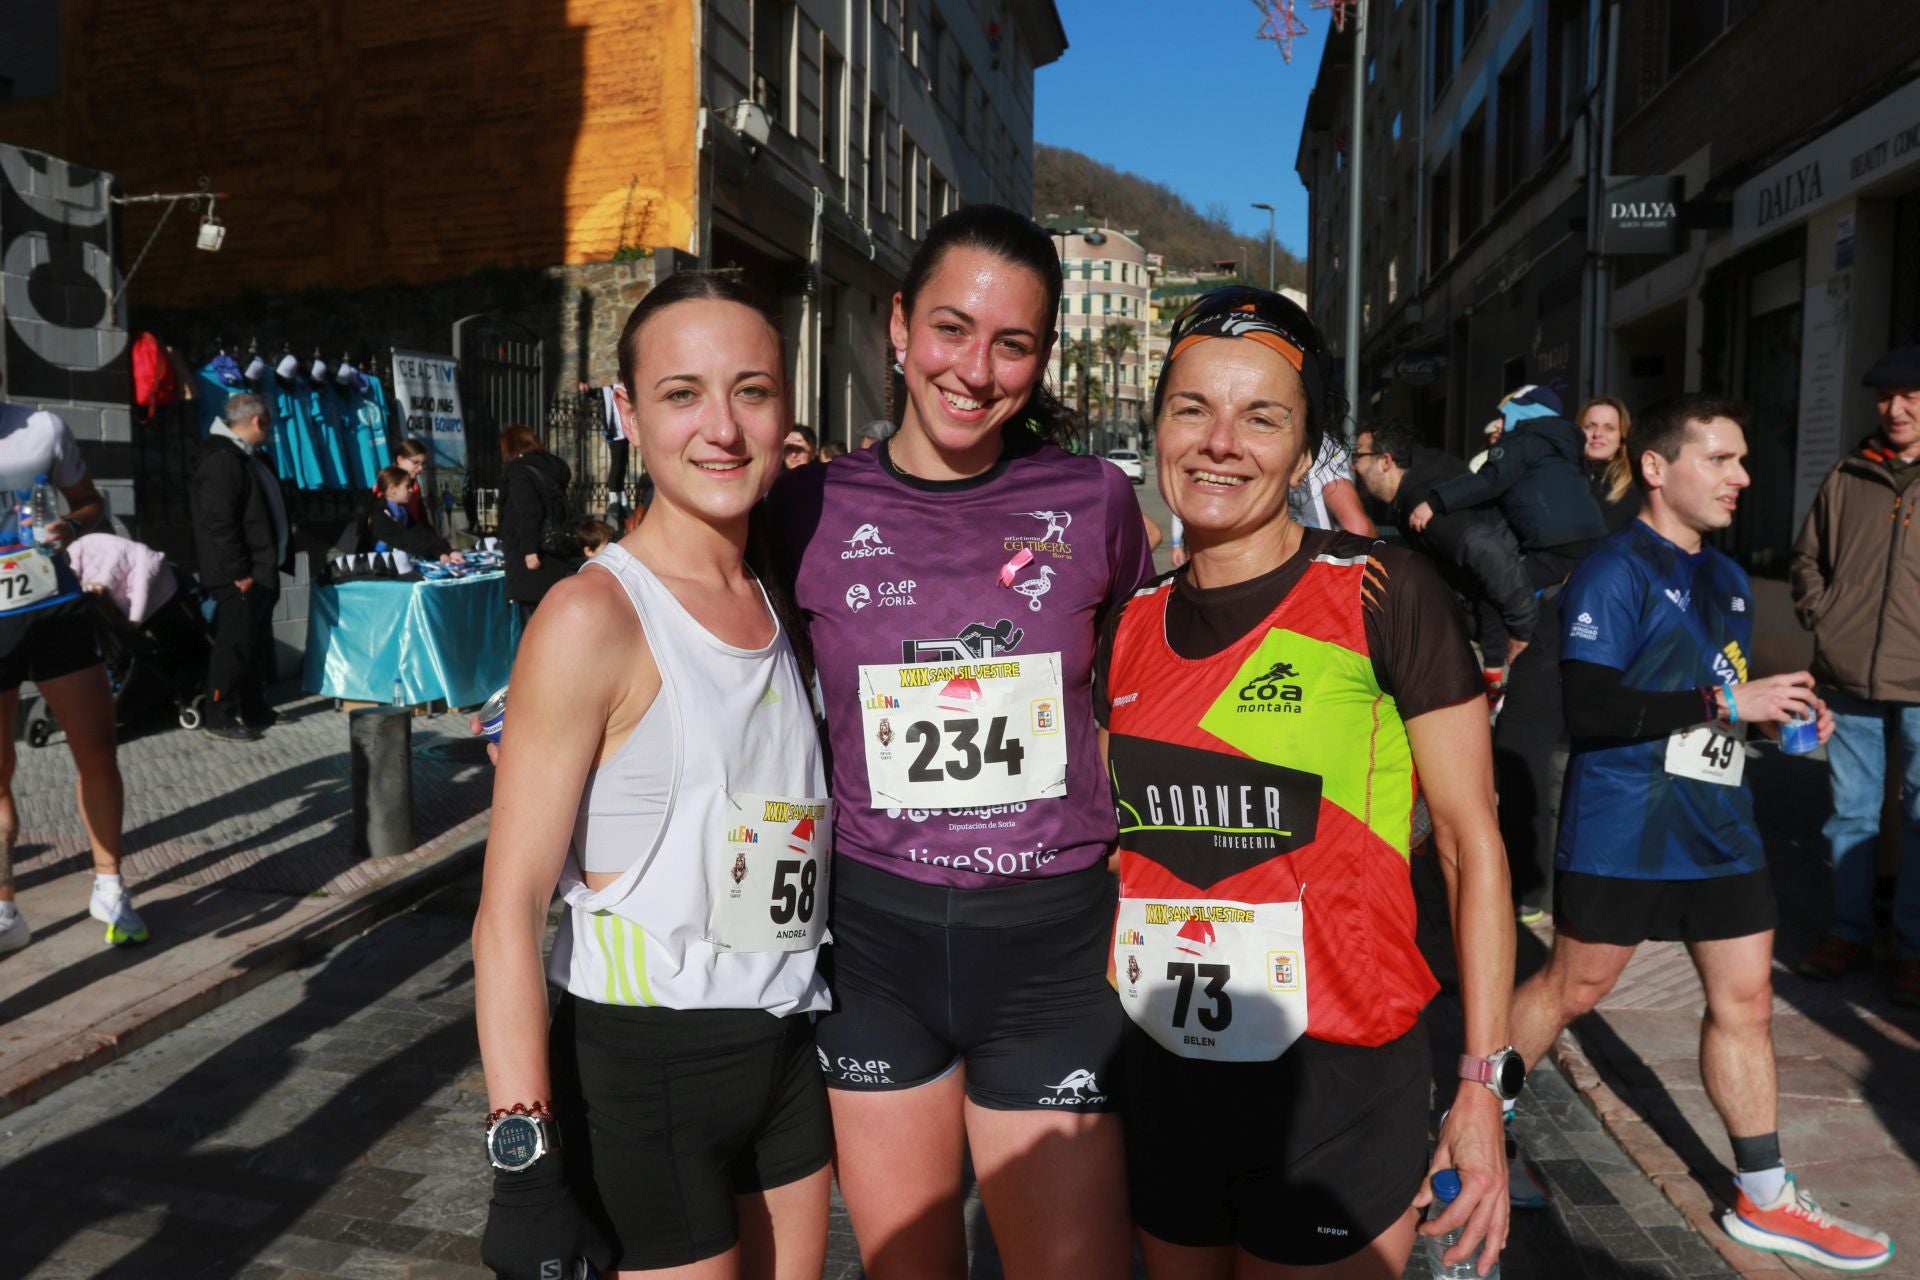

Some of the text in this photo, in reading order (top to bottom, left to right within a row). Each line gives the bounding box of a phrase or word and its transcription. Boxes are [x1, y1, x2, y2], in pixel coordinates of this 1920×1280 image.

[1758, 159, 1823, 227] DALYA
[1611, 202, 1677, 218] DALYA
[435, 416, 463, 432] EQUIPO
[841, 547, 895, 560] austral
[0, 574, 33, 600] 72
[899, 662, 1020, 687] XXIX SAN SILVESTRE
[866, 693, 900, 710] LLENA
[1239, 684, 1303, 702] coa
[1236, 702, 1302, 714] montaña
[905, 716, 1025, 783] 234
[1701, 733, 1735, 769] 49
[763, 801, 790, 823] XXIX
[1146, 784, 1280, 830] CORNER
[948, 816, 1016, 832] Diputación de Soria
[727, 824, 759, 844] LLENA
[1213, 834, 1276, 849] CERVECERIA
[770, 858, 817, 925] 58
[1145, 904, 1255, 925] XXIX SAN SILVESTRE
[776, 929, 807, 939] ANDREA
[1119, 928, 1145, 946] LLENA
[1166, 961, 1233, 1032] 73
[1183, 1035, 1216, 1047] BELEN
[1317, 1226, 1348, 1236] KIPRUN
